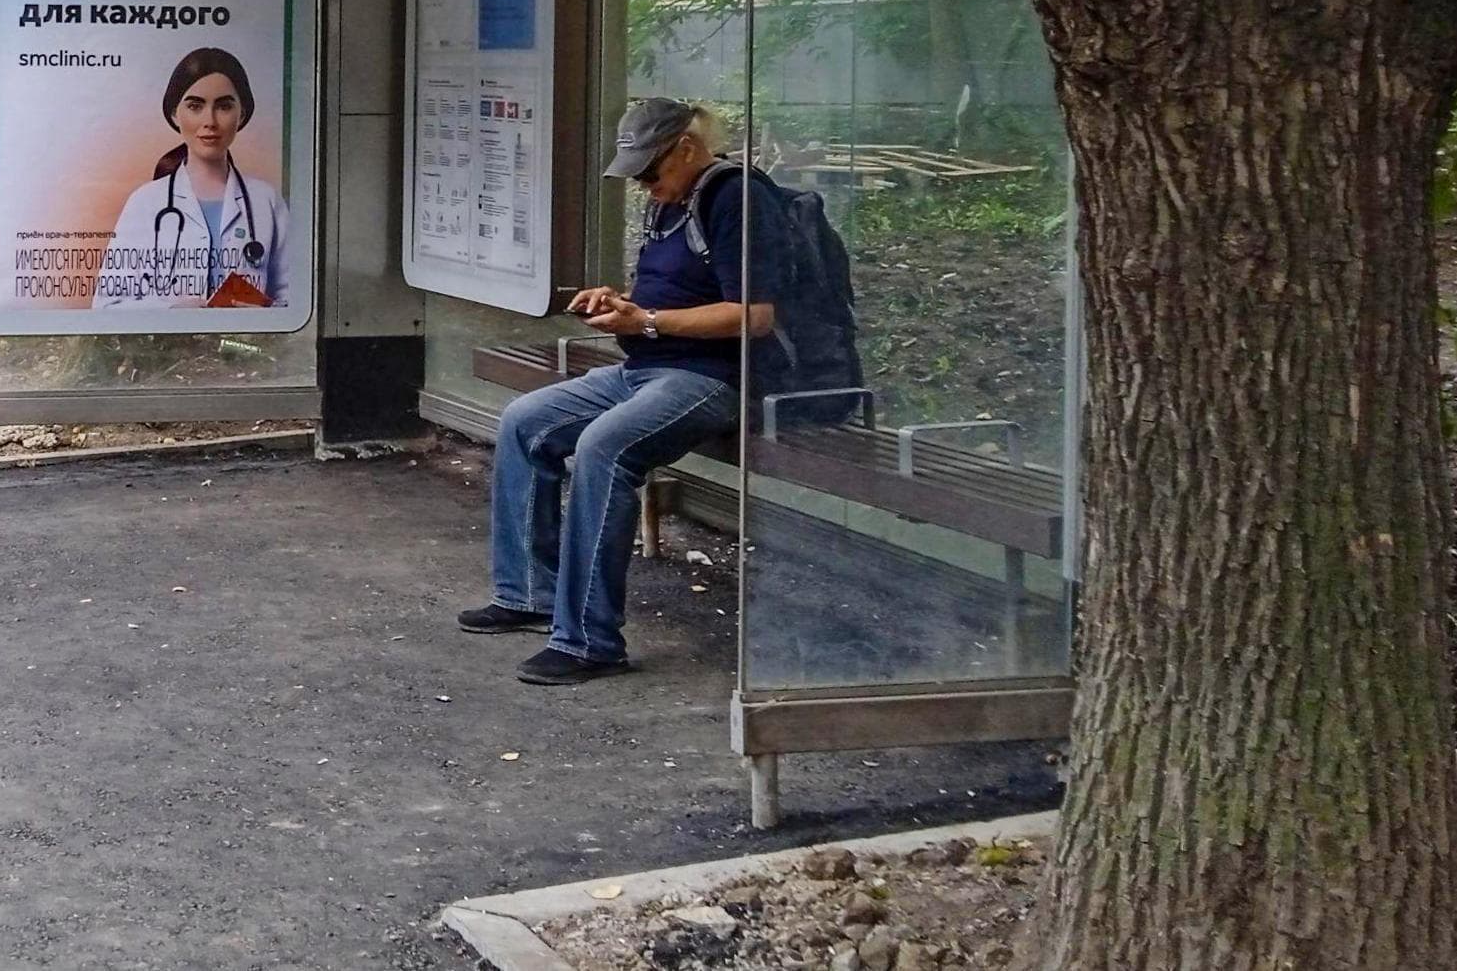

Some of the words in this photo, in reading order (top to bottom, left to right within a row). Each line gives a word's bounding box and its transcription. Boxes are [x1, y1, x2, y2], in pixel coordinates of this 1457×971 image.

[19, 3, 82, 27] для
[90, 3, 231, 29] каждого
[19, 49, 121, 67] smclinic.ru
[16, 230, 44, 240] приём
[15, 247, 70, 270] ИМЕЮТСЯ
[15, 275, 154, 297] ПРОКОНСУЛЬТИРОВАТЬСЯ
